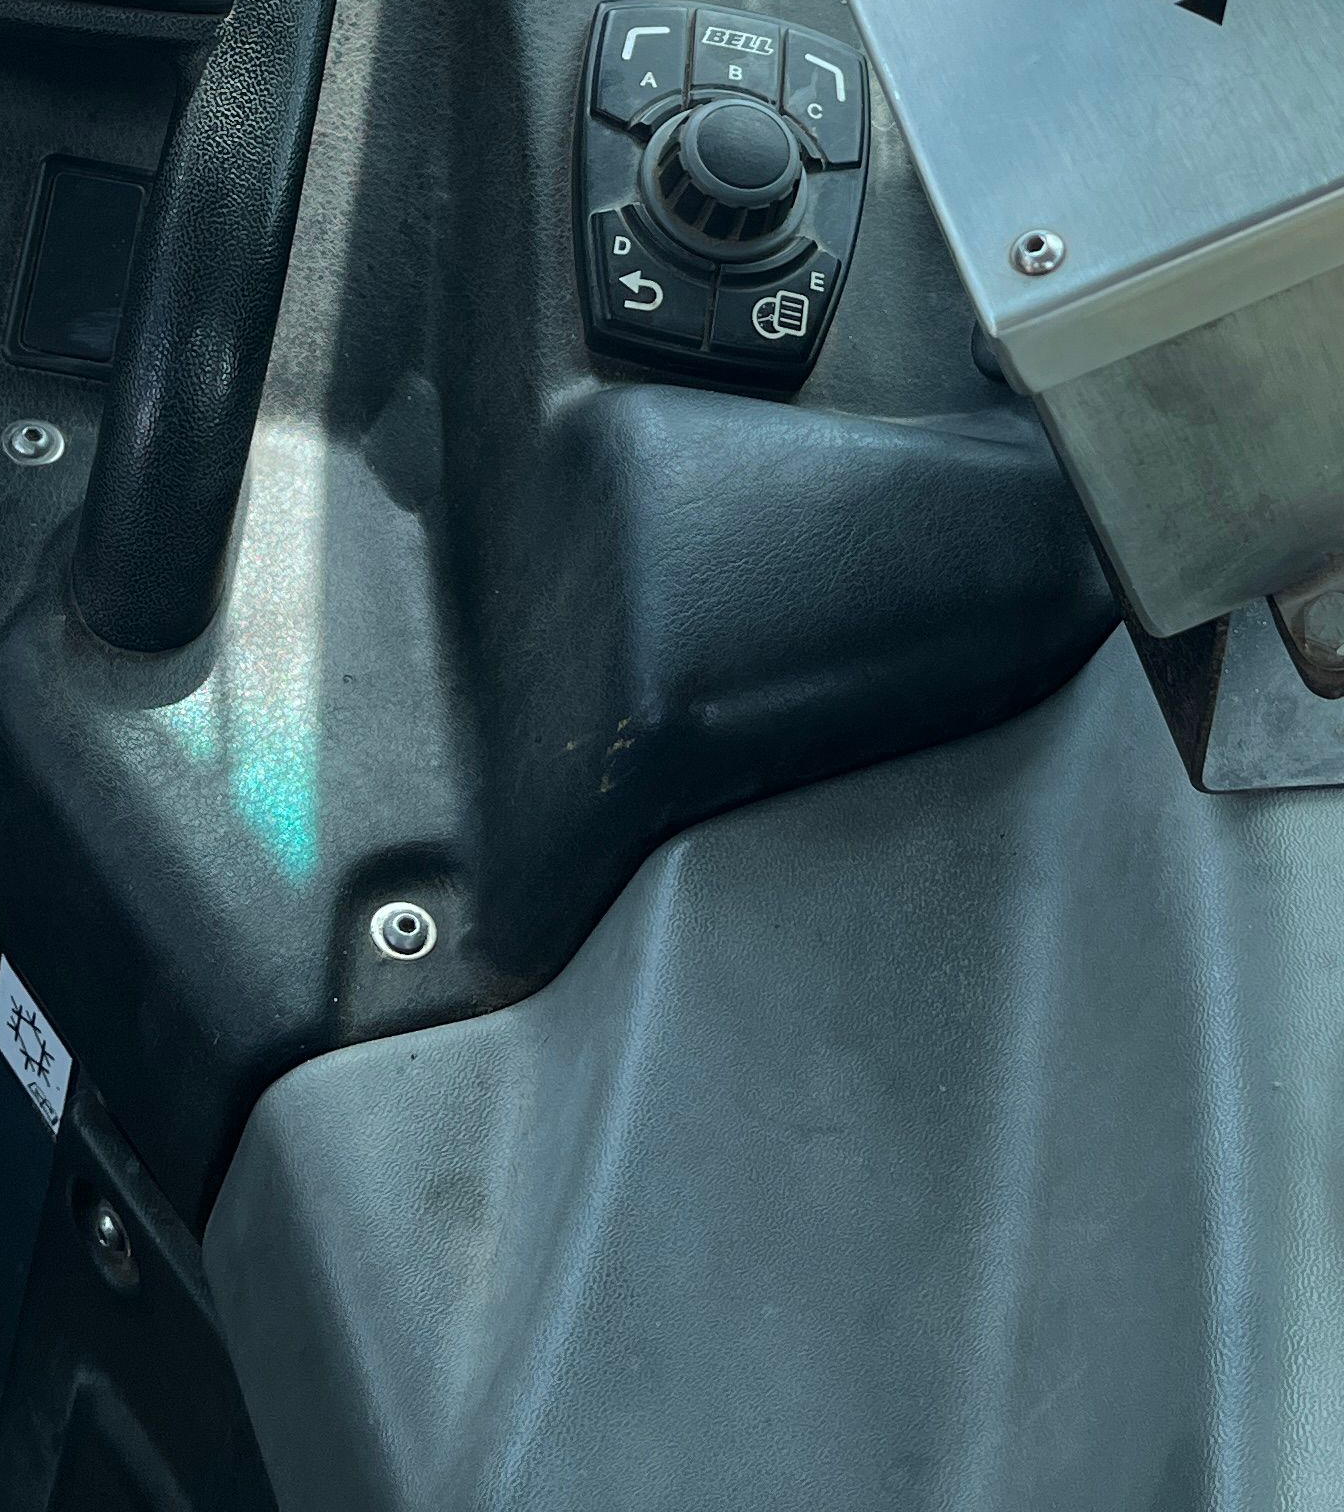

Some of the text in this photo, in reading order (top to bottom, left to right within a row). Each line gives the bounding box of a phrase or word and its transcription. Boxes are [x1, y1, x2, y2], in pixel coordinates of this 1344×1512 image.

[701, 25, 775, 55] BELL
[639, 71, 658, 88] A
[728, 64, 743, 81] B
[807, 102, 824, 120] C
[612, 235, 632, 256] D
[810, 270, 826, 293] E
